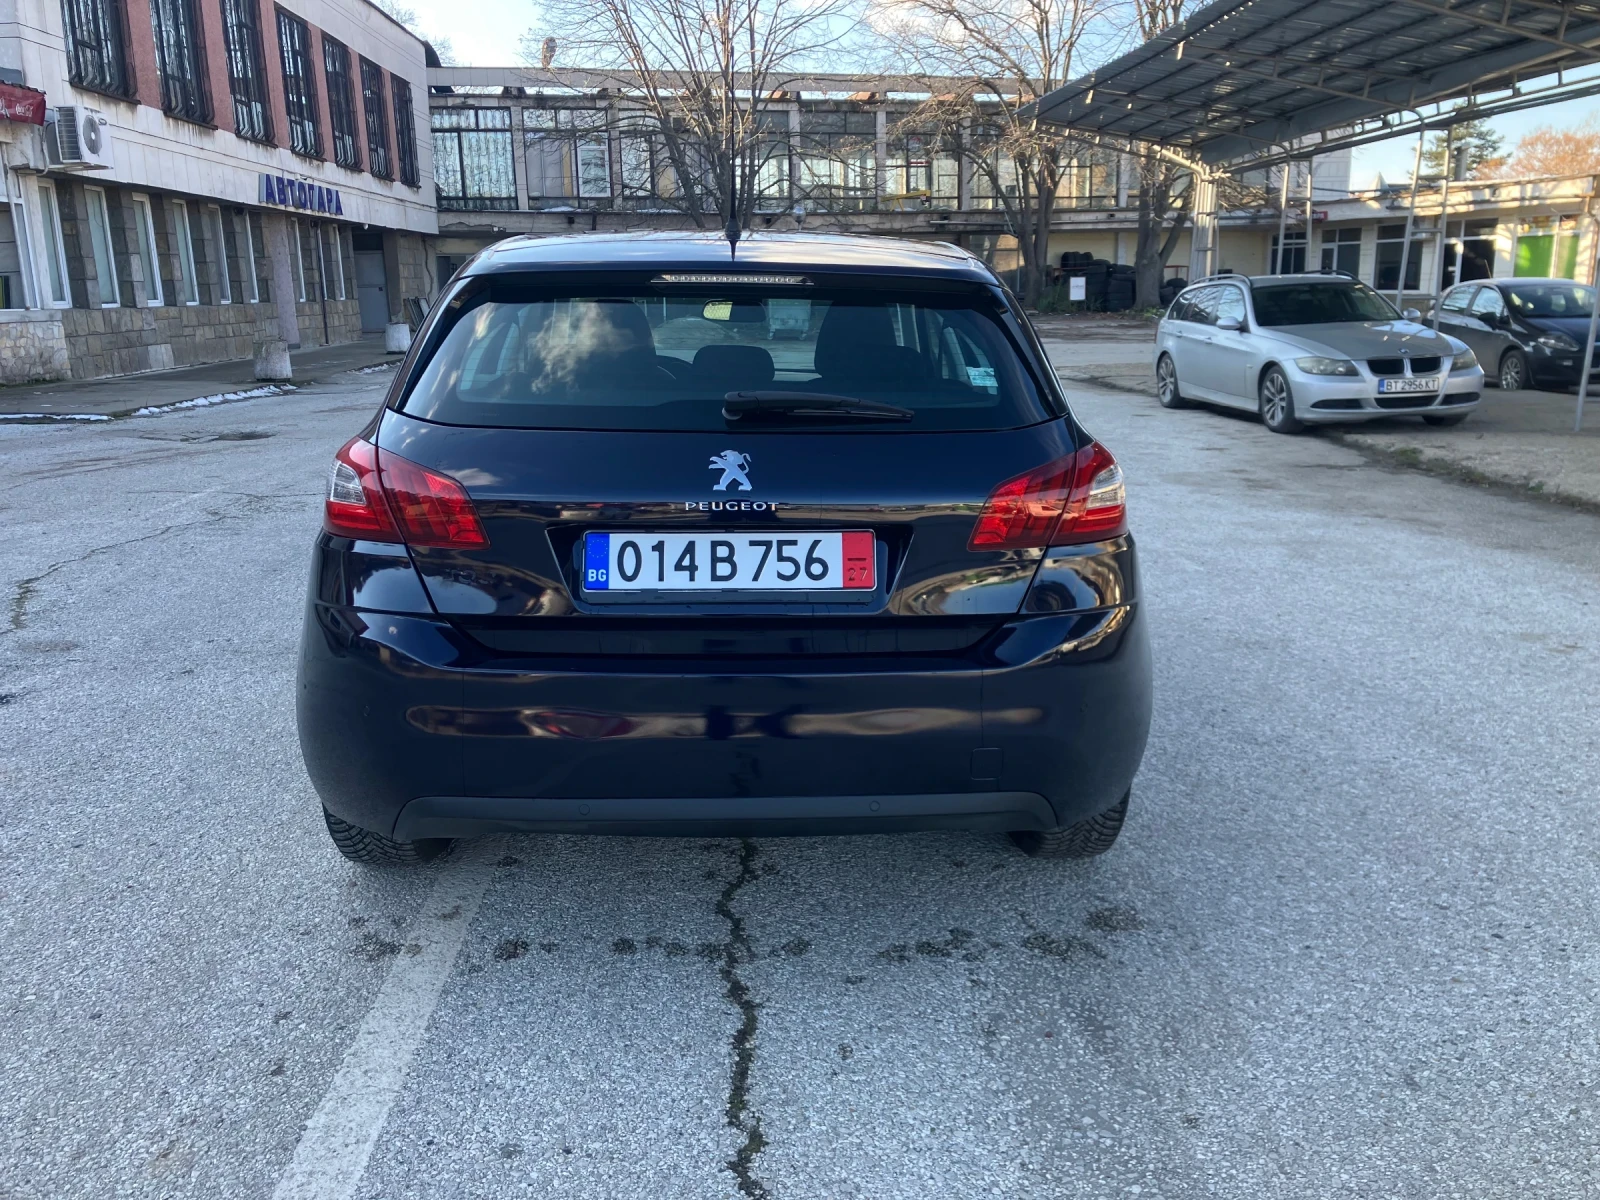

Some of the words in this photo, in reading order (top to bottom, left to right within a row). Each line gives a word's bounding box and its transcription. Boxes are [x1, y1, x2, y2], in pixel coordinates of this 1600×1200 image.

[262, 174, 343, 215] АВТОГАРА
[684, 501, 780, 511] PEUGEOT
[588, 569, 607, 581] BG
[847, 567, 868, 582] 27
